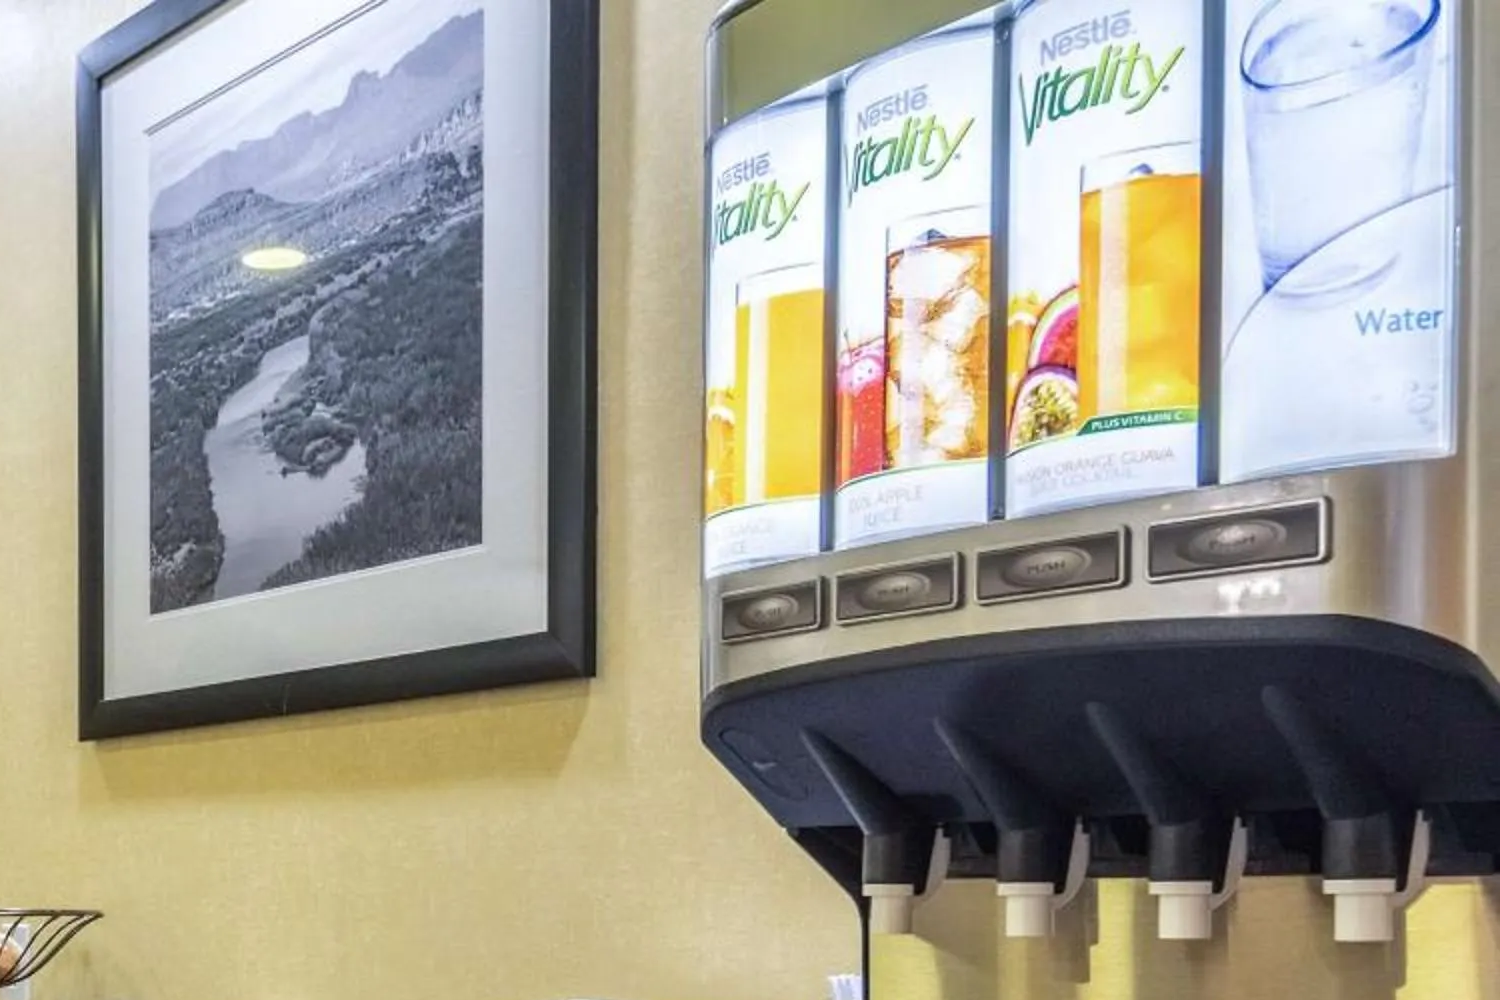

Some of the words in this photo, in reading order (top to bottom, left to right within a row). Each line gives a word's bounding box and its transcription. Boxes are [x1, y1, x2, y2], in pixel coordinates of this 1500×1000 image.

[1019, 42, 1186, 148] Vitality
[716, 179, 811, 246] itality
[1354, 307, 1444, 337] Water
[1091, 417, 1120, 432] PLUS
[1121, 410, 1172, 428] VITAMIN
[1173, 408, 1186, 421] C
